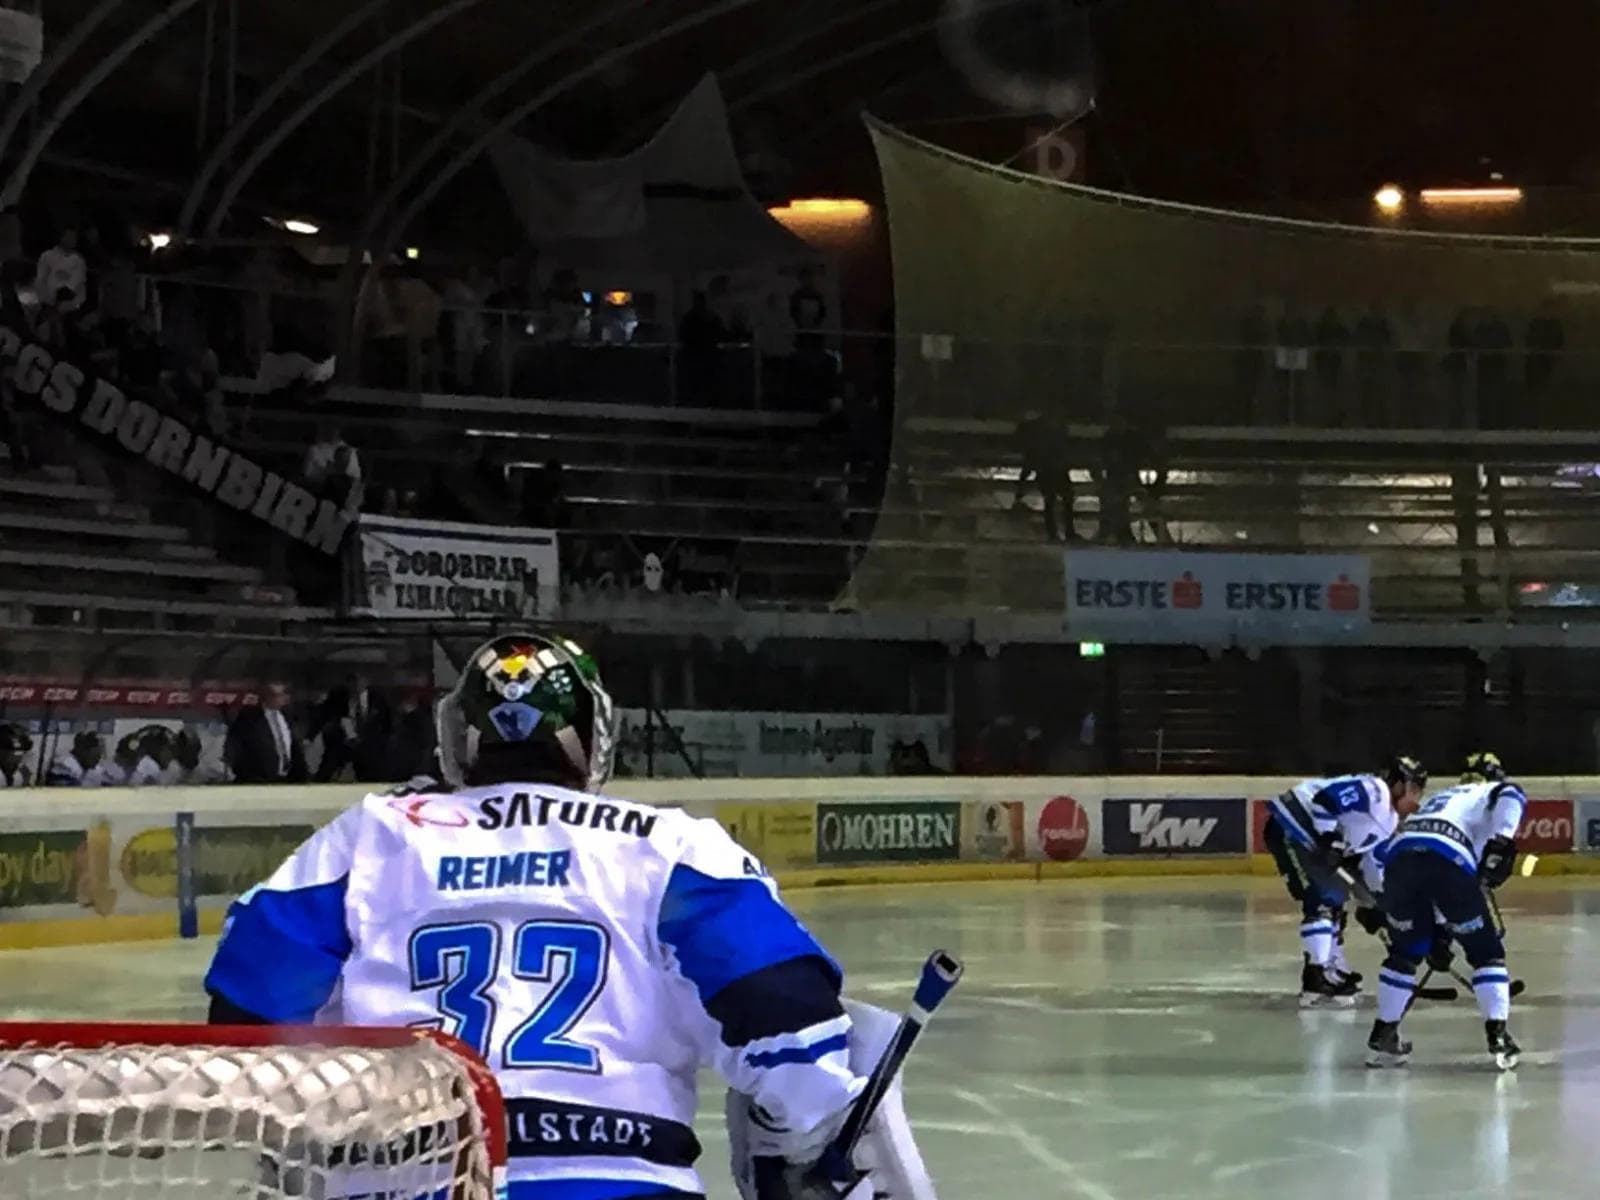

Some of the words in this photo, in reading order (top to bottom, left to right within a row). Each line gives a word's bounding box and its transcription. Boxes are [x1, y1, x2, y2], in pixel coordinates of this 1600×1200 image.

[80, 377, 346, 555] DORNBIRN
[1076, 579, 1167, 609] ERSTE
[1226, 582, 1321, 611] ERSTE
[477, 792, 657, 837] SATURN
[842, 812, 956, 850] MOHREN
[437, 850, 571, 891] REIMER
[408, 918, 611, 1075] 32
[504, 1112, 652, 1147] LSTADT
